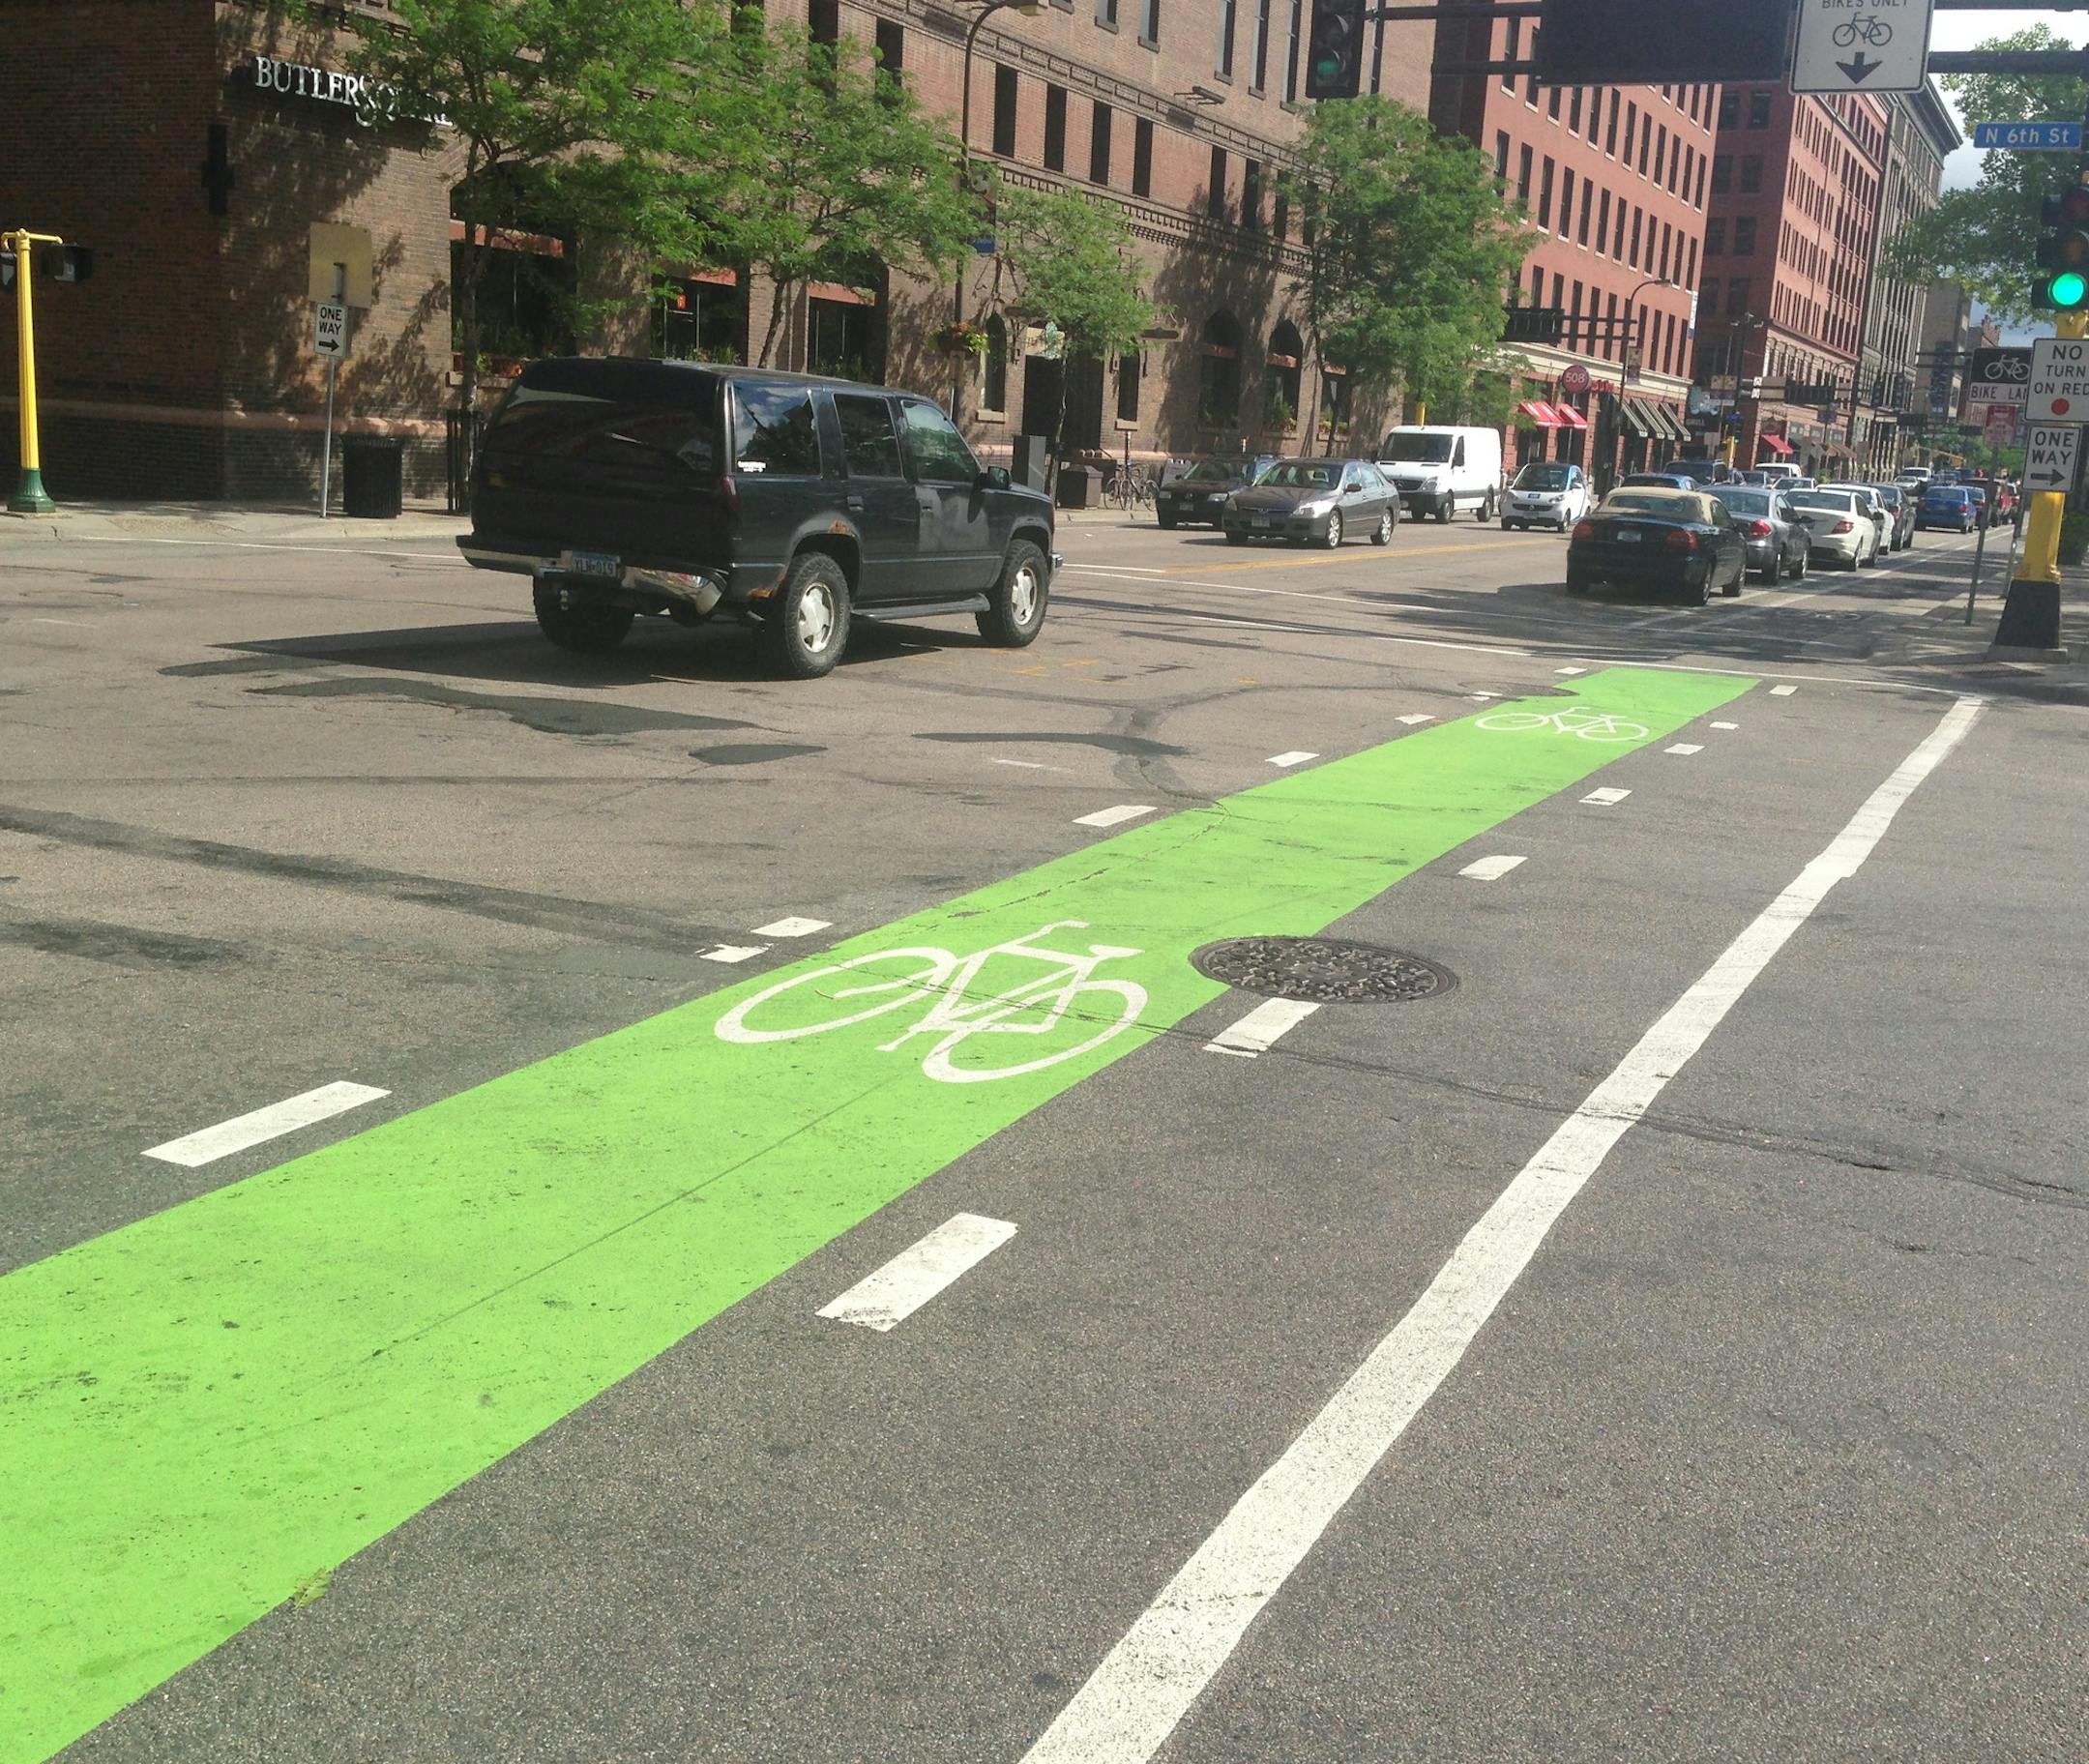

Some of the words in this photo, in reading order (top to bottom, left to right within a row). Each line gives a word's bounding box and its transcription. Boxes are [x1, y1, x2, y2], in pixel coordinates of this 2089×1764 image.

[255, 56, 360, 107] BUTLER
[1986, 128, 1999, 144] N
[2007, 128, 2040, 144] 6th
[2048, 128, 2070, 144] St
[320, 307, 342, 321] ONE
[319, 321, 342, 336] WAY
[2052, 344, 2082, 361] NO
[1565, 372, 1586, 384] 508
[2045, 365, 2087, 378] TURN
[1971, 385, 1997, 399] BIKE
[2008, 387, 2028, 400] LA
[2034, 382, 2055, 395] ON
[2035, 430, 2074, 448] ONE
[2032, 449, 2073, 465] WAY
